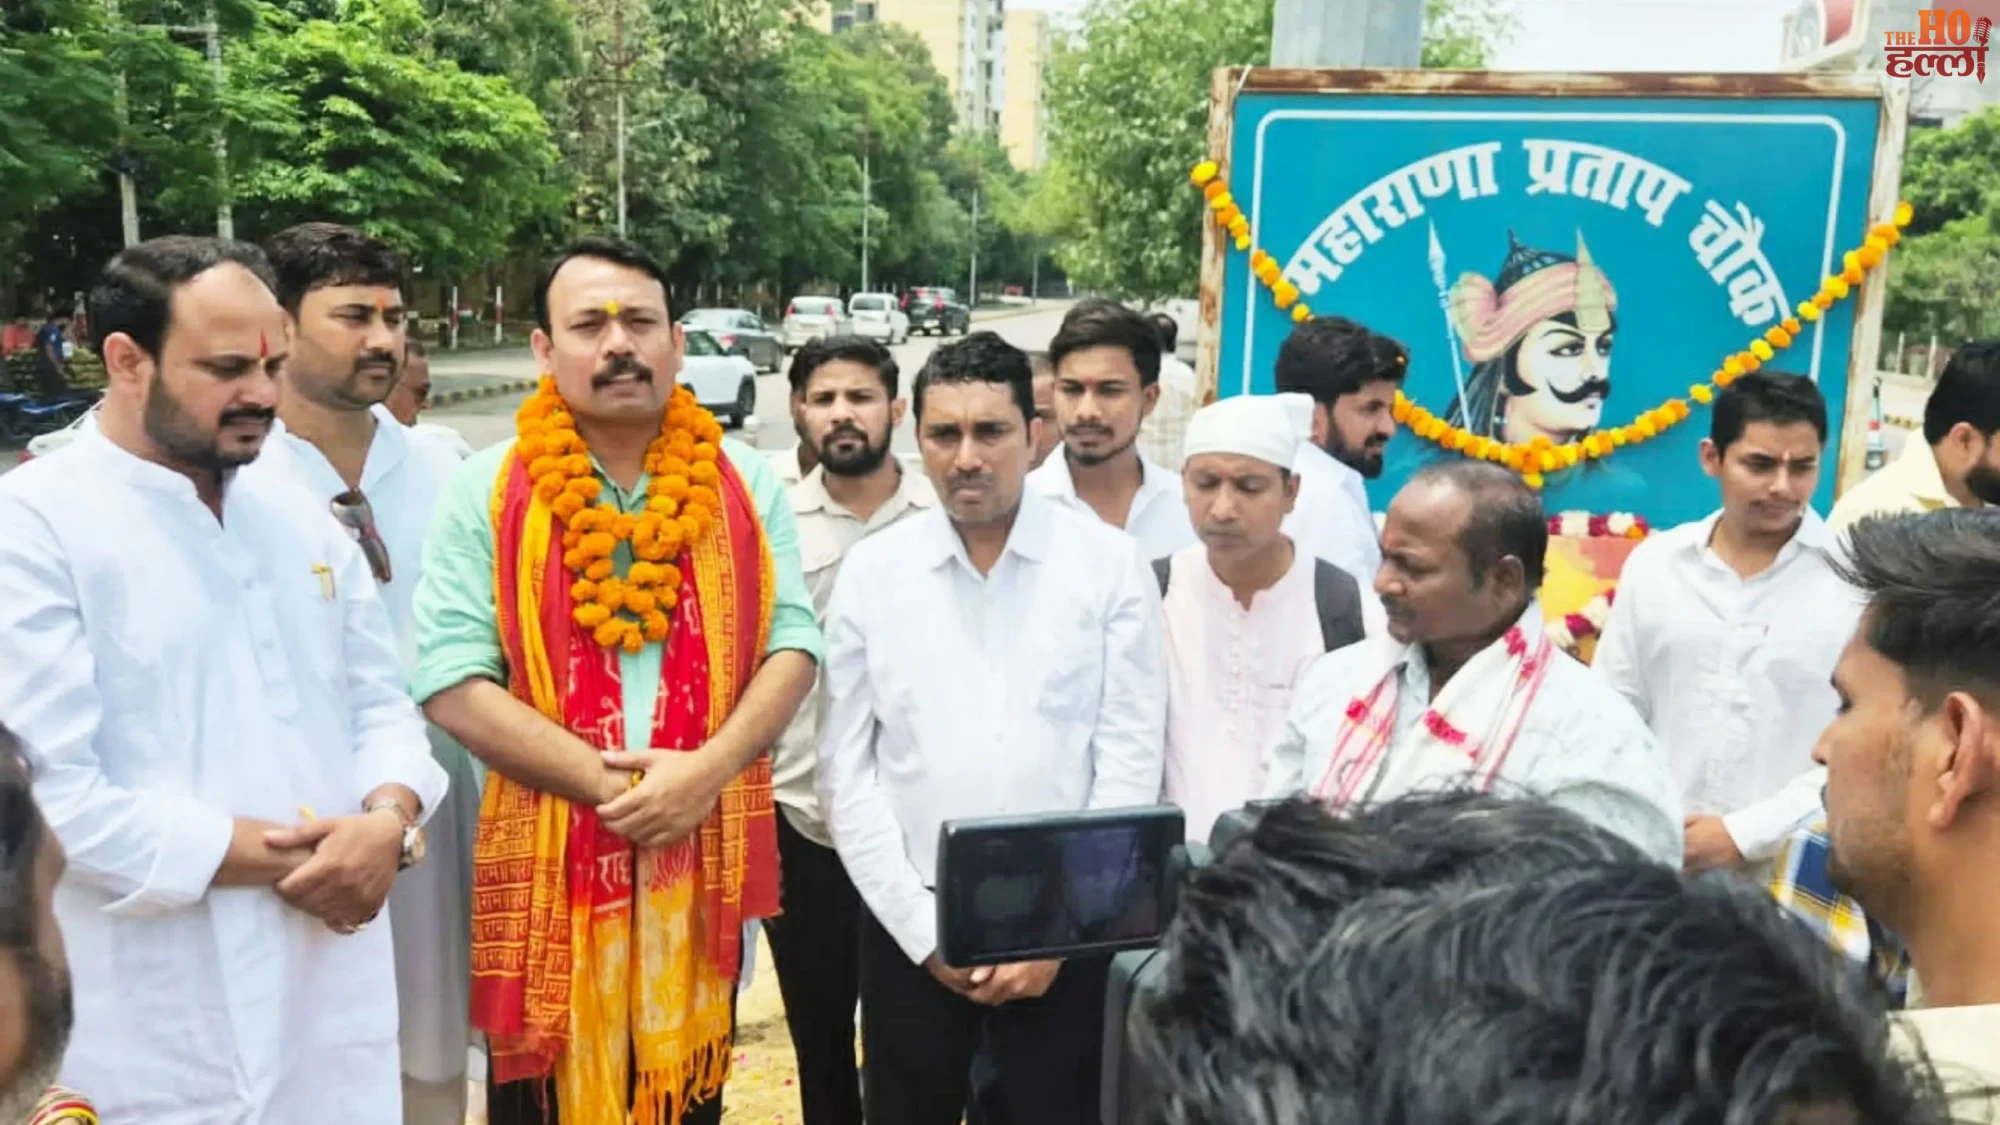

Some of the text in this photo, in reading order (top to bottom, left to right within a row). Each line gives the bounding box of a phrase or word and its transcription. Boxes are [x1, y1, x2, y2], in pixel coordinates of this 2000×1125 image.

[1281, 138, 1793, 327] महाराणा प्रताप चौक
